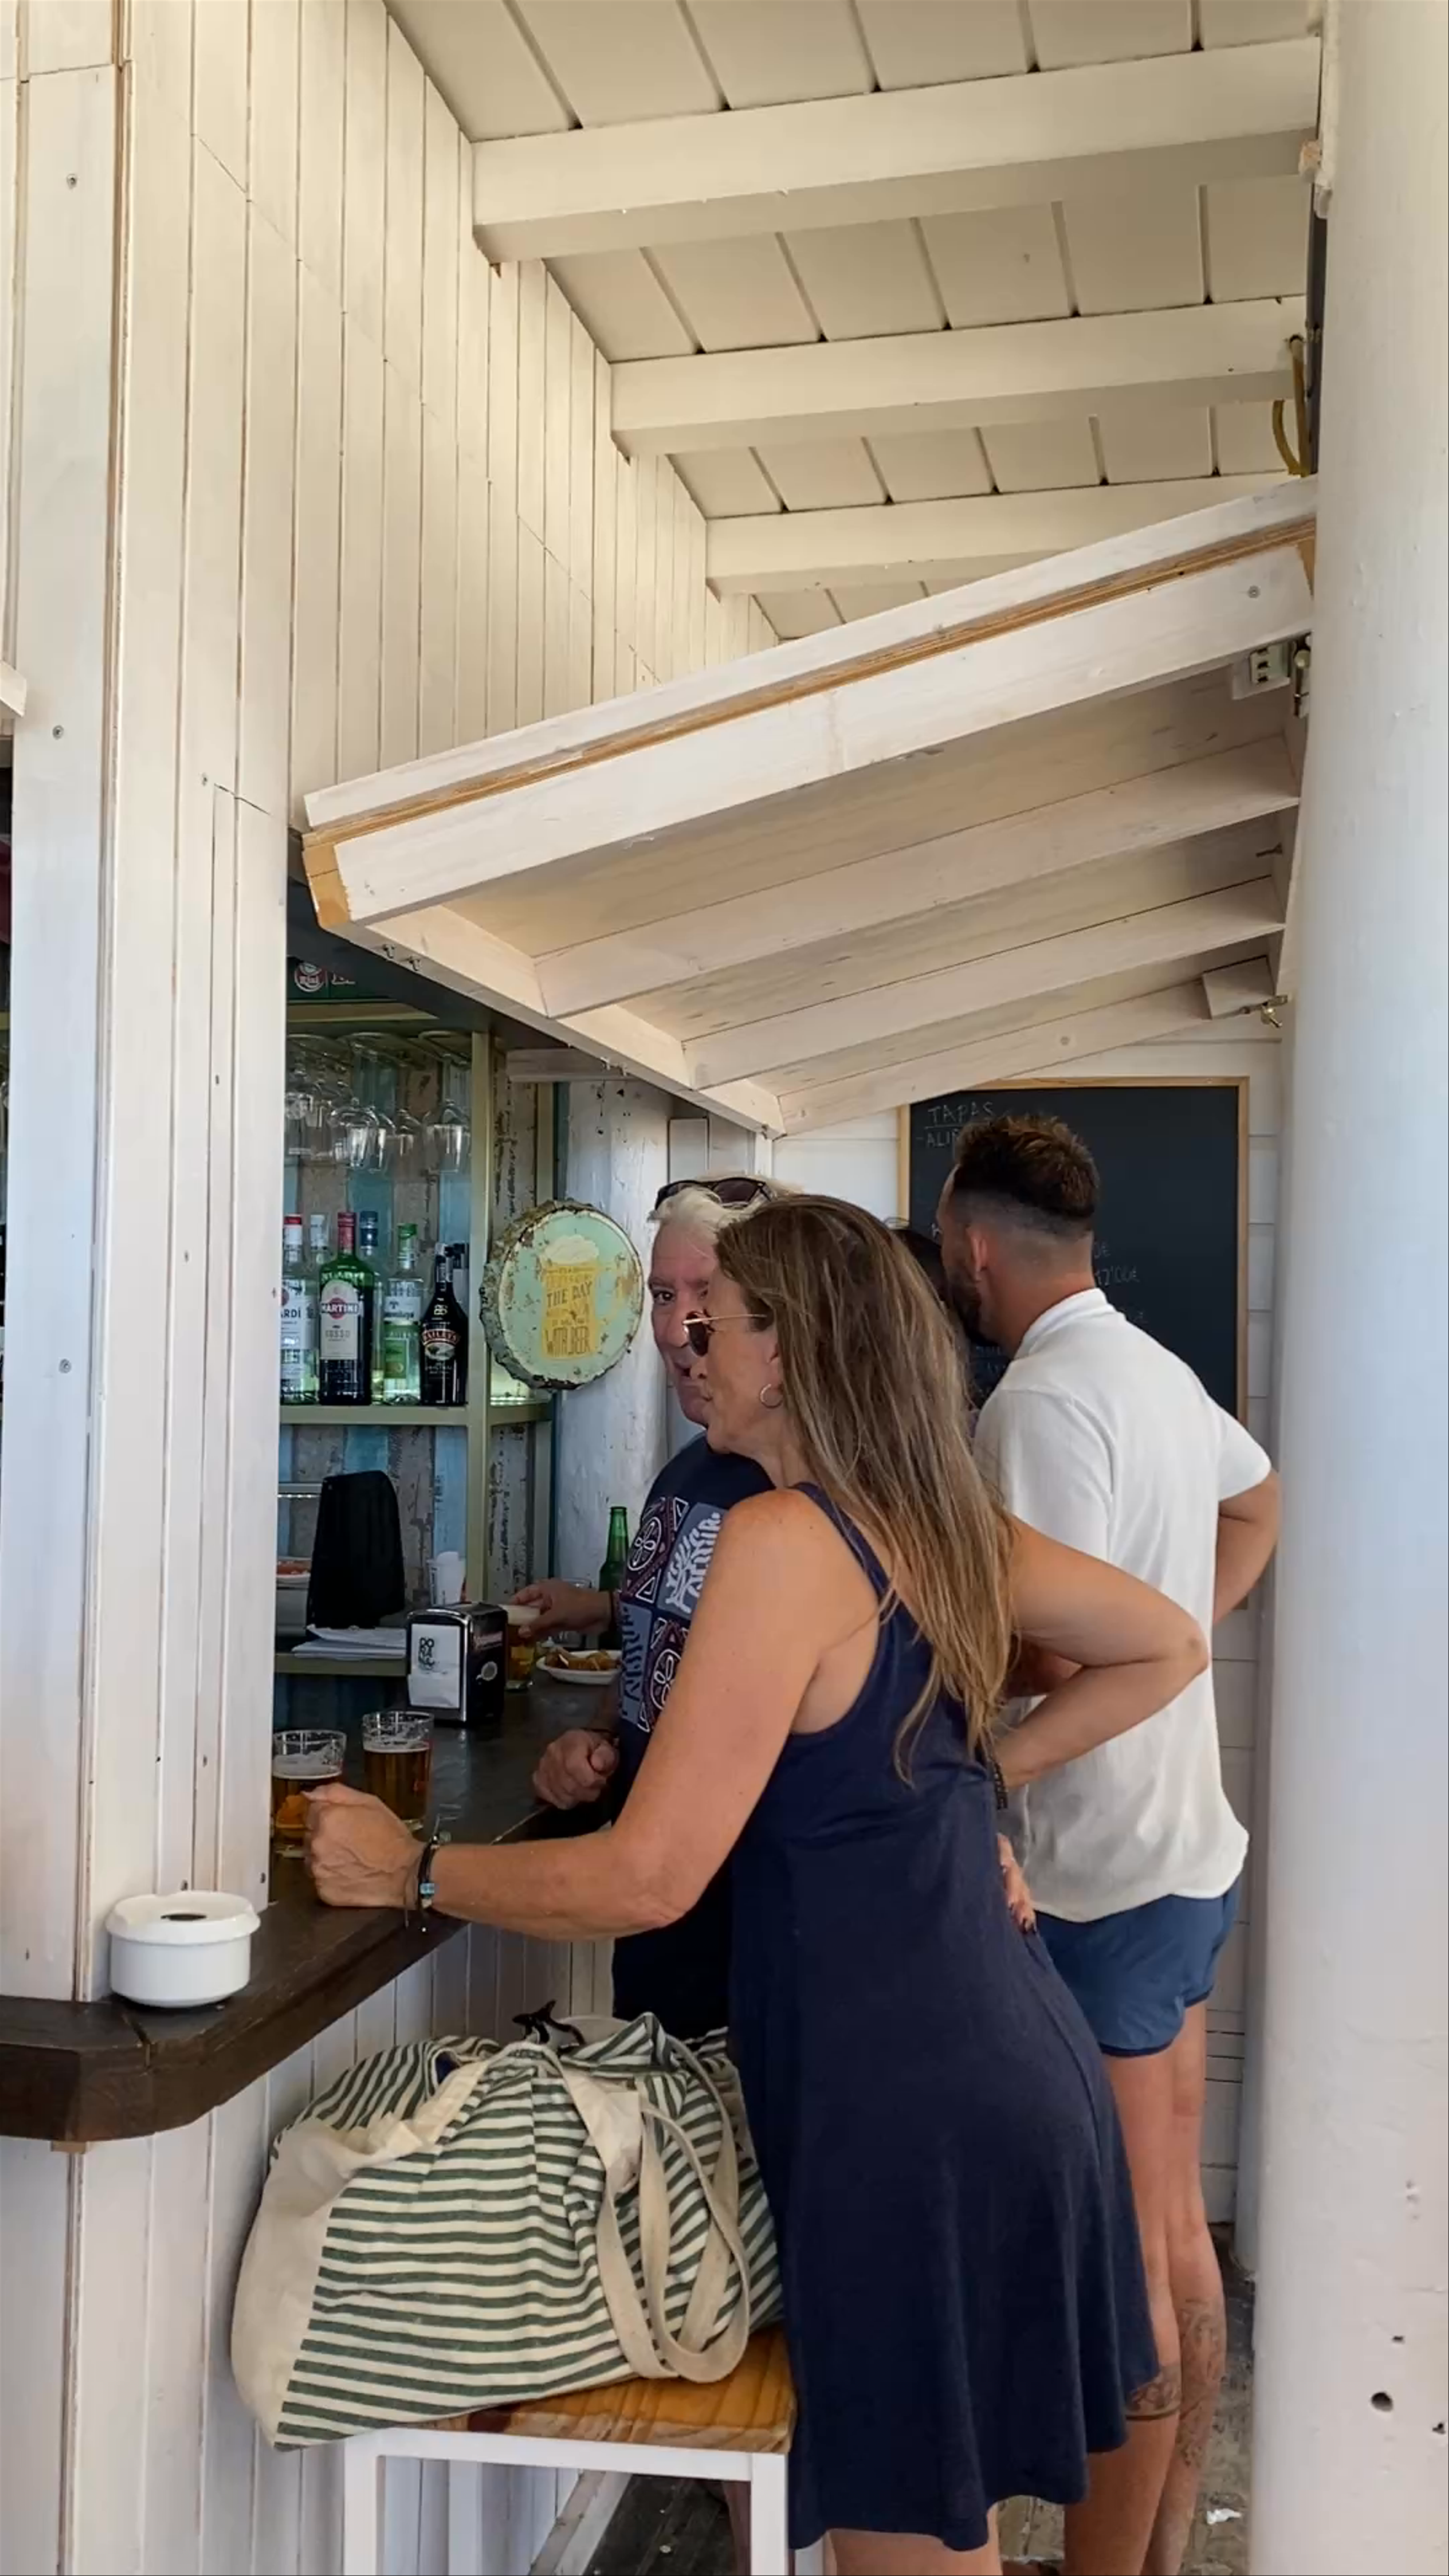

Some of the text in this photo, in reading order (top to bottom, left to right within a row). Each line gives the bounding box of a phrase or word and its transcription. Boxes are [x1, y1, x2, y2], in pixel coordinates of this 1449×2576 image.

[928, 1101, 993, 1123] TAPAS
[547, 1288, 568, 1308] THE
[321, 1304, 358, 1313] MARTINI
